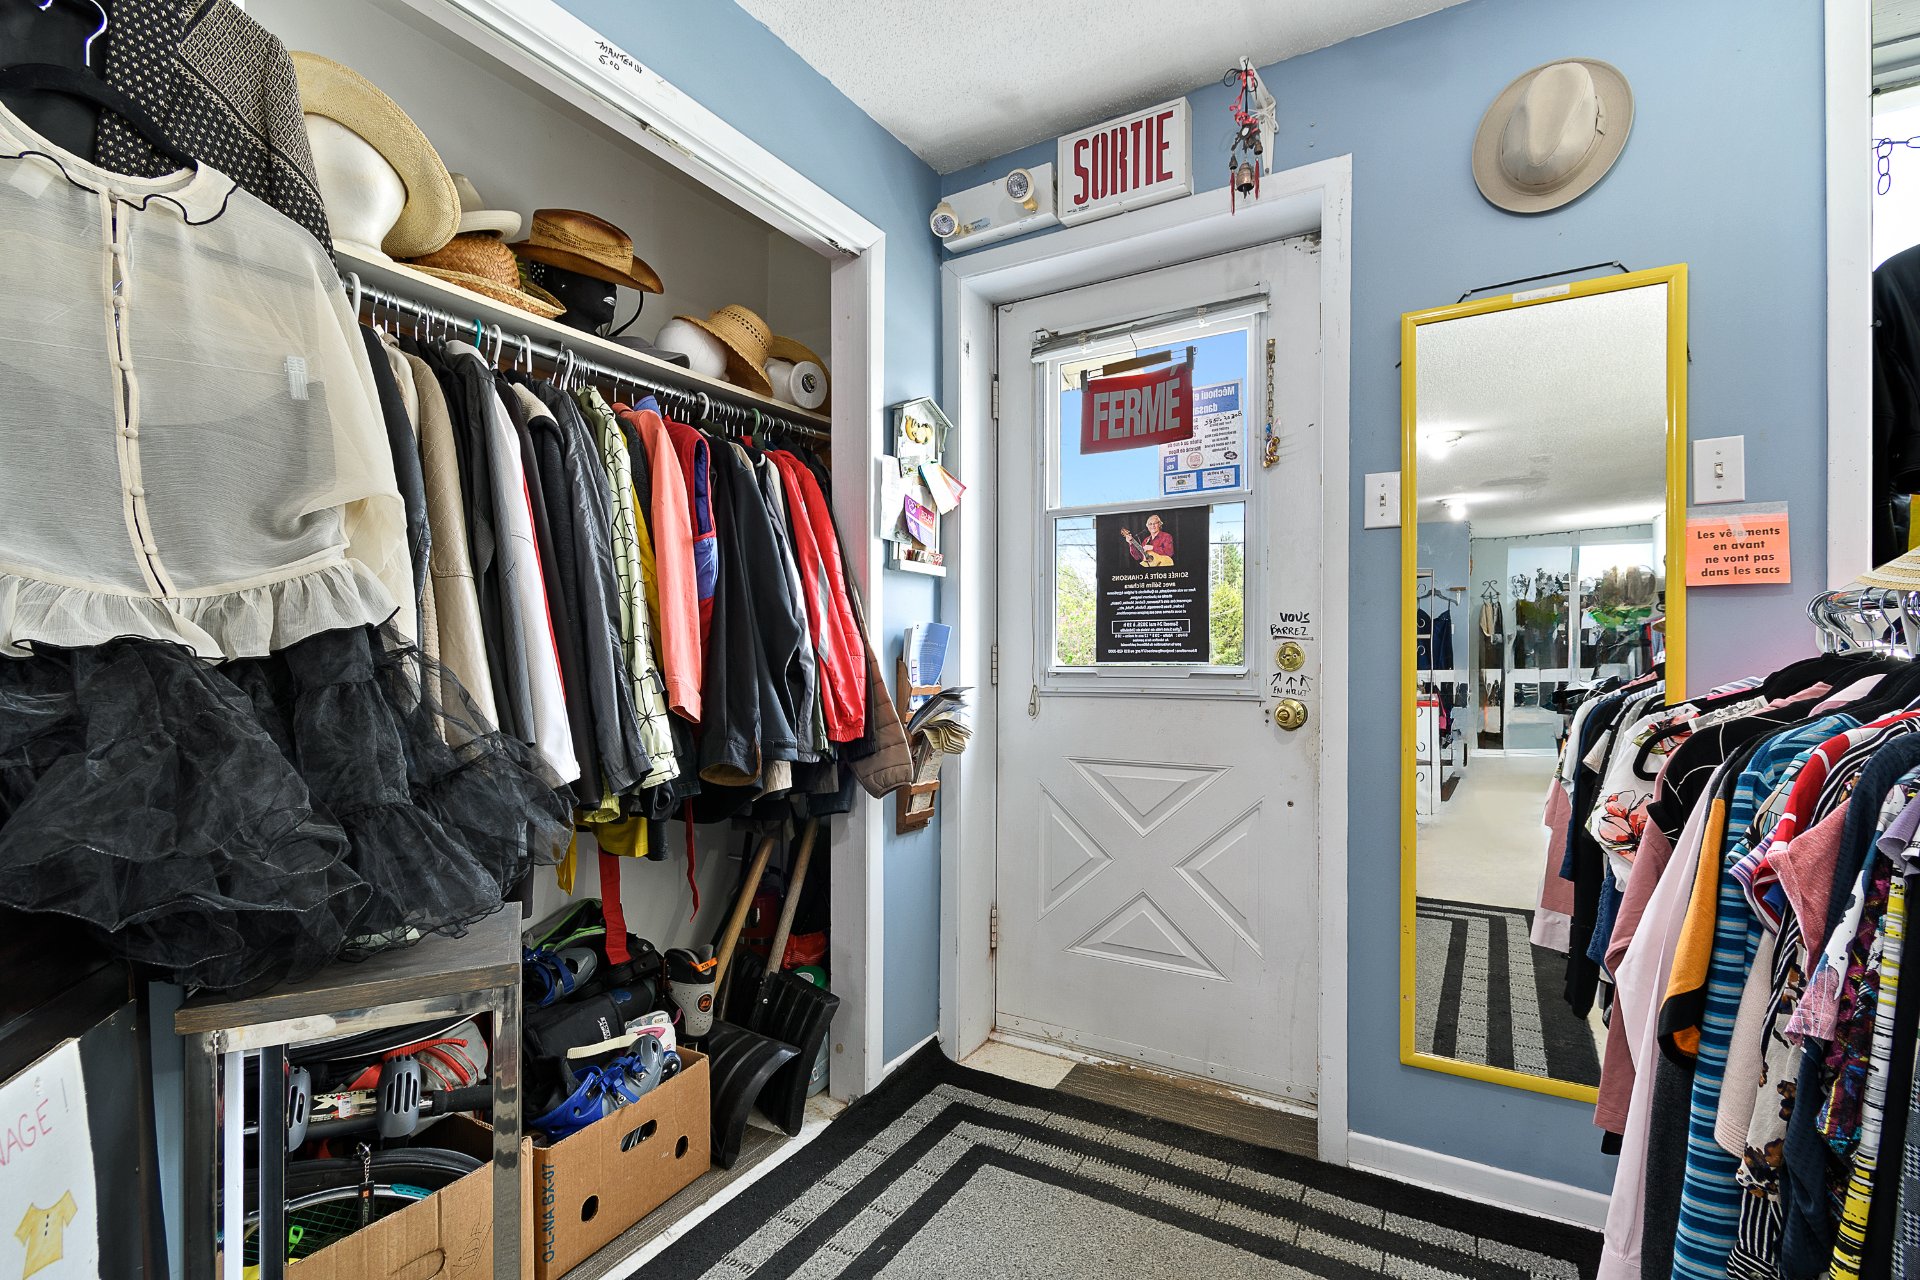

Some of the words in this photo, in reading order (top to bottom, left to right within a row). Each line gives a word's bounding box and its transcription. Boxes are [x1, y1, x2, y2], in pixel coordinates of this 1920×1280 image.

[1073, 110, 1174, 206] SORTIE
[1092, 366, 1181, 442] FERMÉ
[1697, 530, 1715, 539] Les
[1719, 527, 1781, 538] vêtements
[1713, 543, 1727, 551] en
[1731, 540, 1766, 550] avant
[1705, 555, 1719, 564] ne
[1723, 553, 1750, 563] vont
[1753, 553, 1775, 563] pas
[1701, 567, 1730, 577] dans
[1734, 565, 1751, 575] les
[1755, 566, 1781, 575] sacs
[1279, 611, 1310, 624] VOUS
[1270, 623, 1309, 636] BARREZ
[1272, 685, 1283, 694] EN
[0, 1098, 53, 1166] AGE
